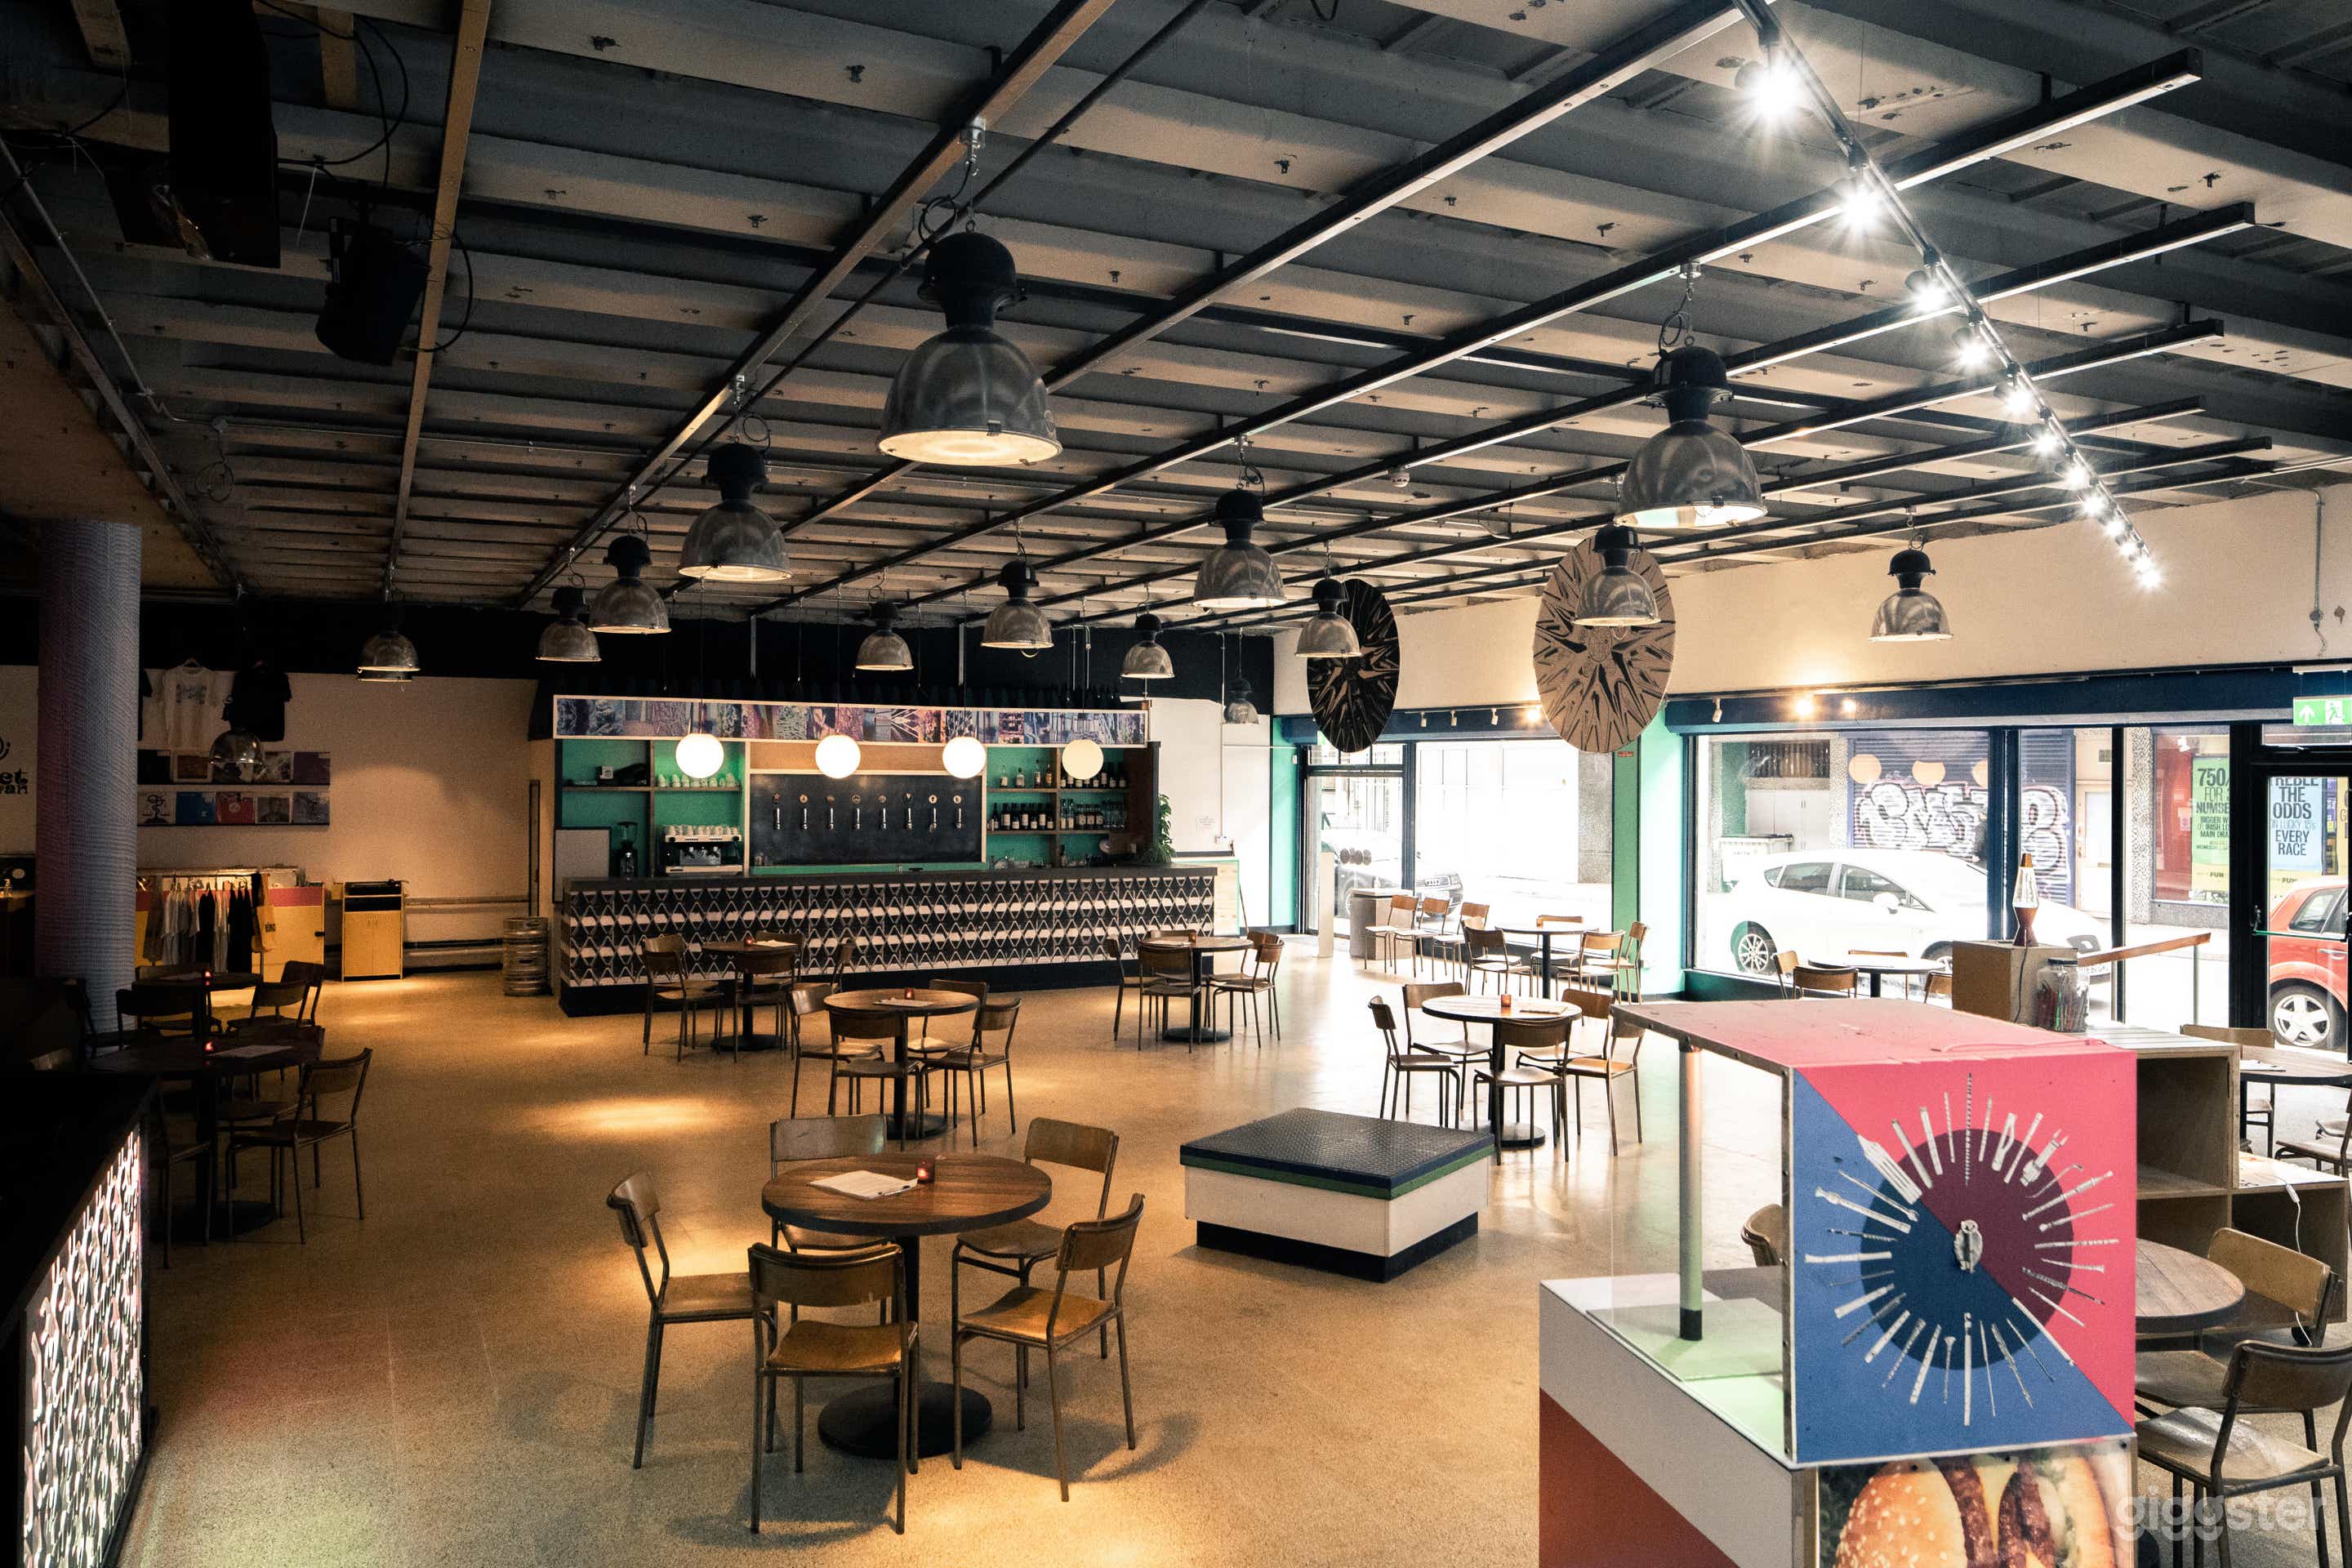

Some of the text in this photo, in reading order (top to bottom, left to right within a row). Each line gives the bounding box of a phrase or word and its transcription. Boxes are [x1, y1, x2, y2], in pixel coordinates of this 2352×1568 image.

[2205, 787, 2223, 802] FOR
[2278, 786, 2305, 802] THE
[2273, 802, 2312, 819] ODDS
[2275, 830, 2310, 843] EVERY
[2278, 843, 2307, 856] RACE
